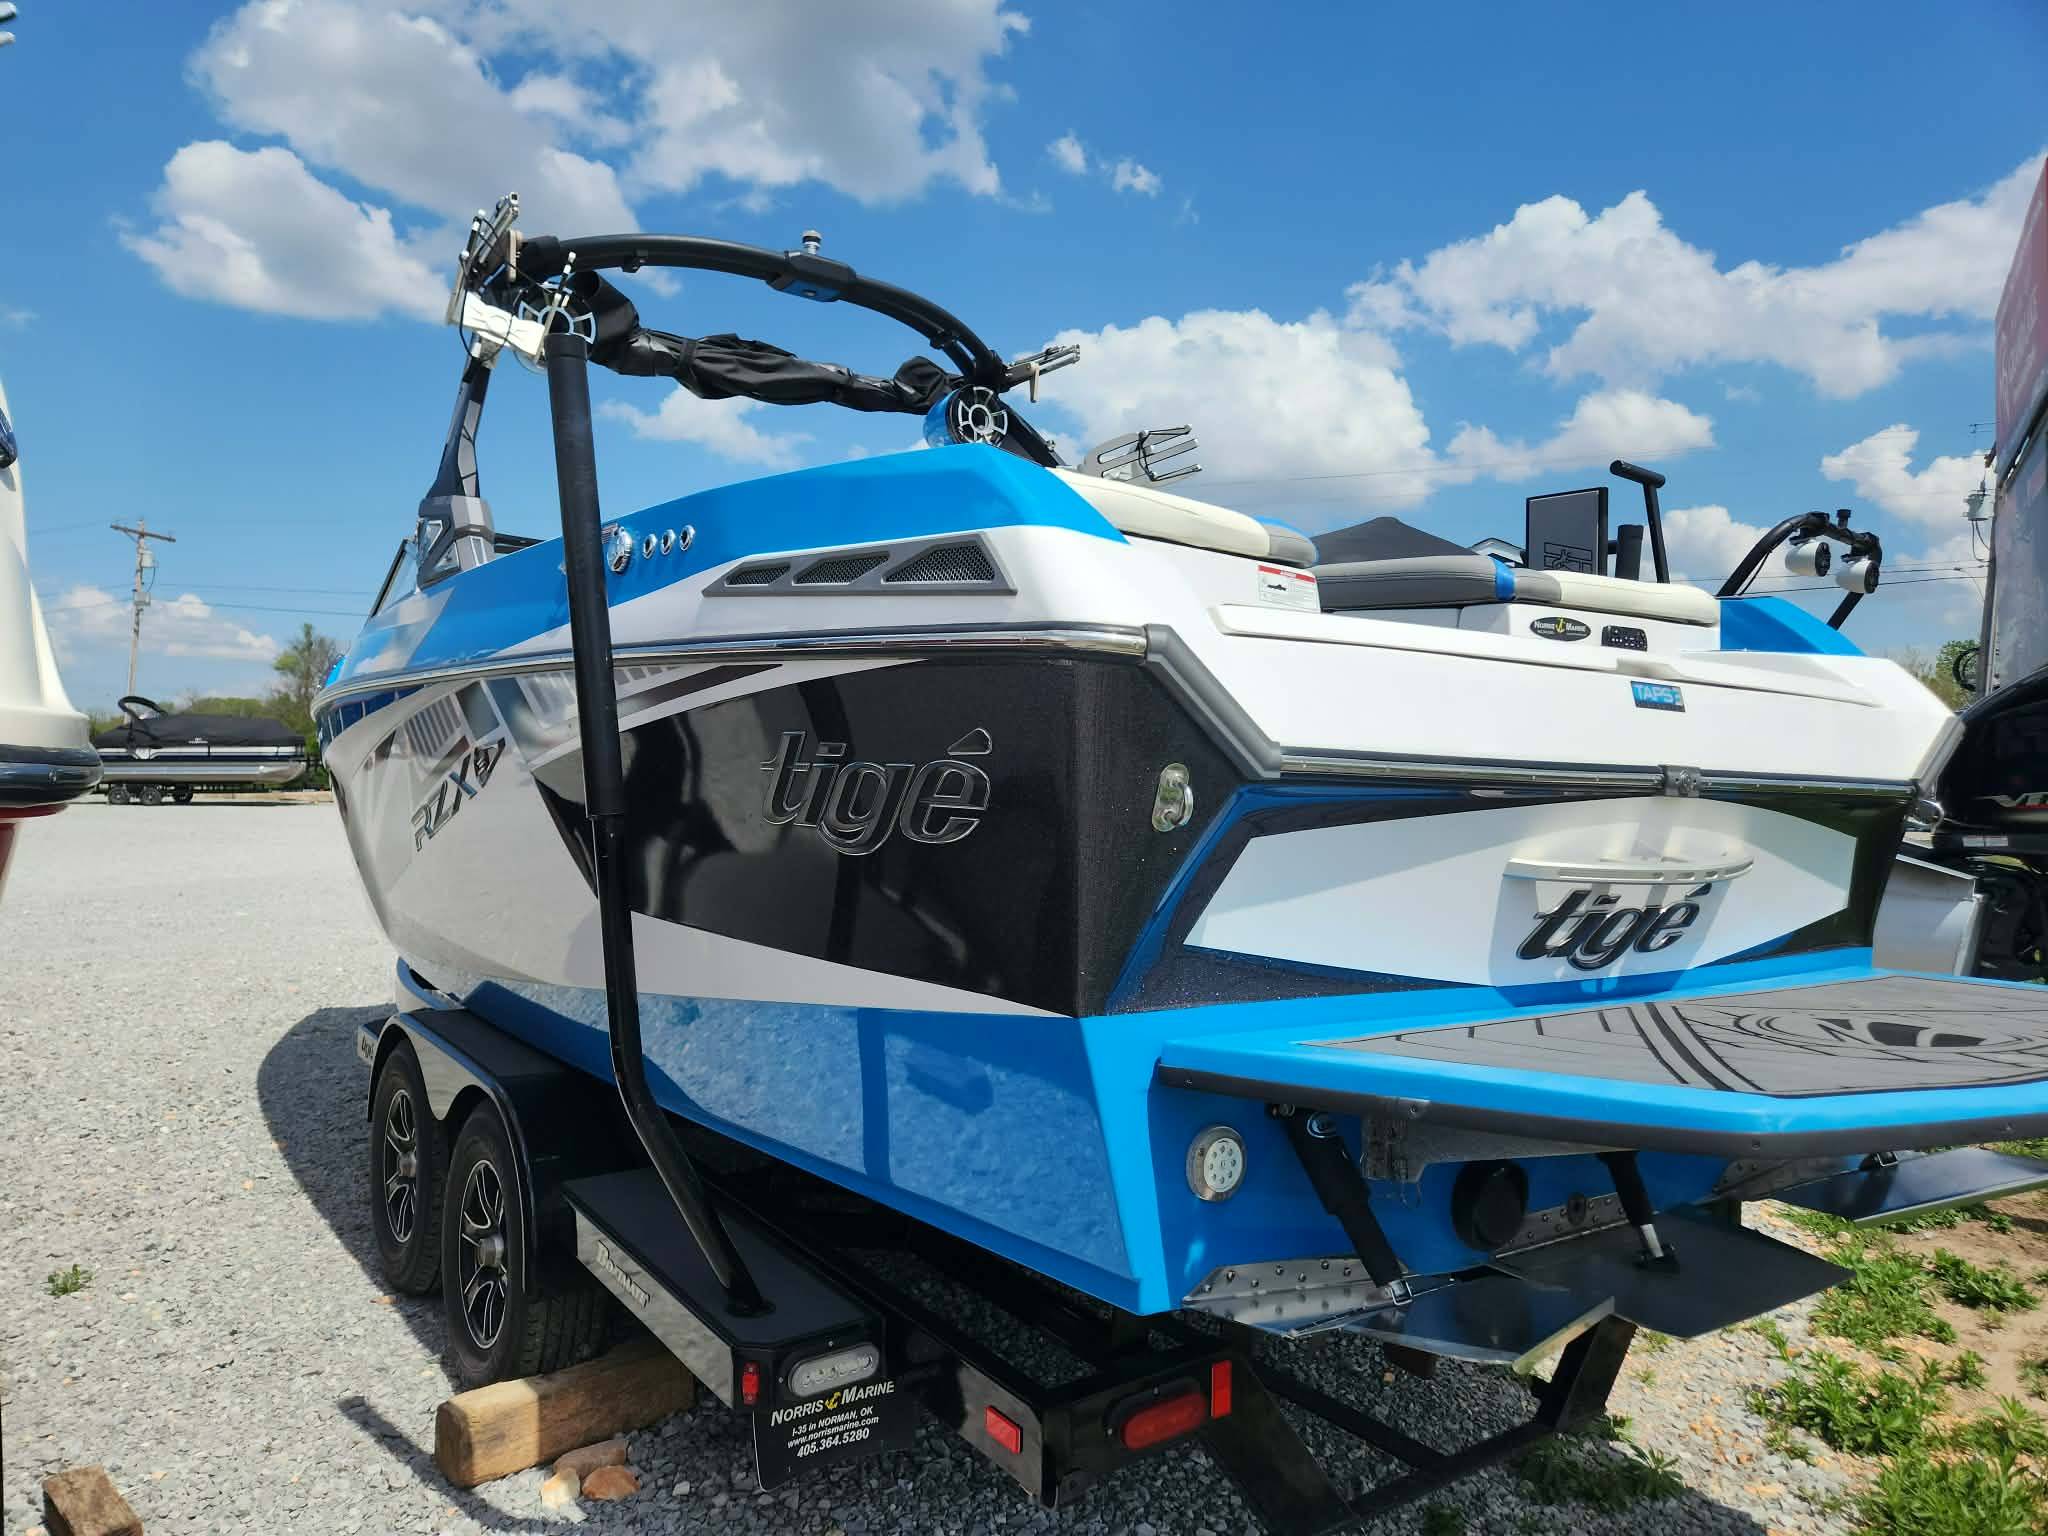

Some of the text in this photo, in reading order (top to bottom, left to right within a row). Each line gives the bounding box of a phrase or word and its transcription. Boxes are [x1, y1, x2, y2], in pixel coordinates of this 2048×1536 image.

[759, 728, 993, 856] tigé
[770, 1381, 895, 1427] NORRIS MARINE
[787, 1416, 880, 1449] www.norrismarine.com
[791, 1424, 808, 1437] I-35
[818, 1410, 859, 1429] NORMAN,
[860, 1405, 874, 1417] OK
[796, 1427, 870, 1458] 405.364.5280
